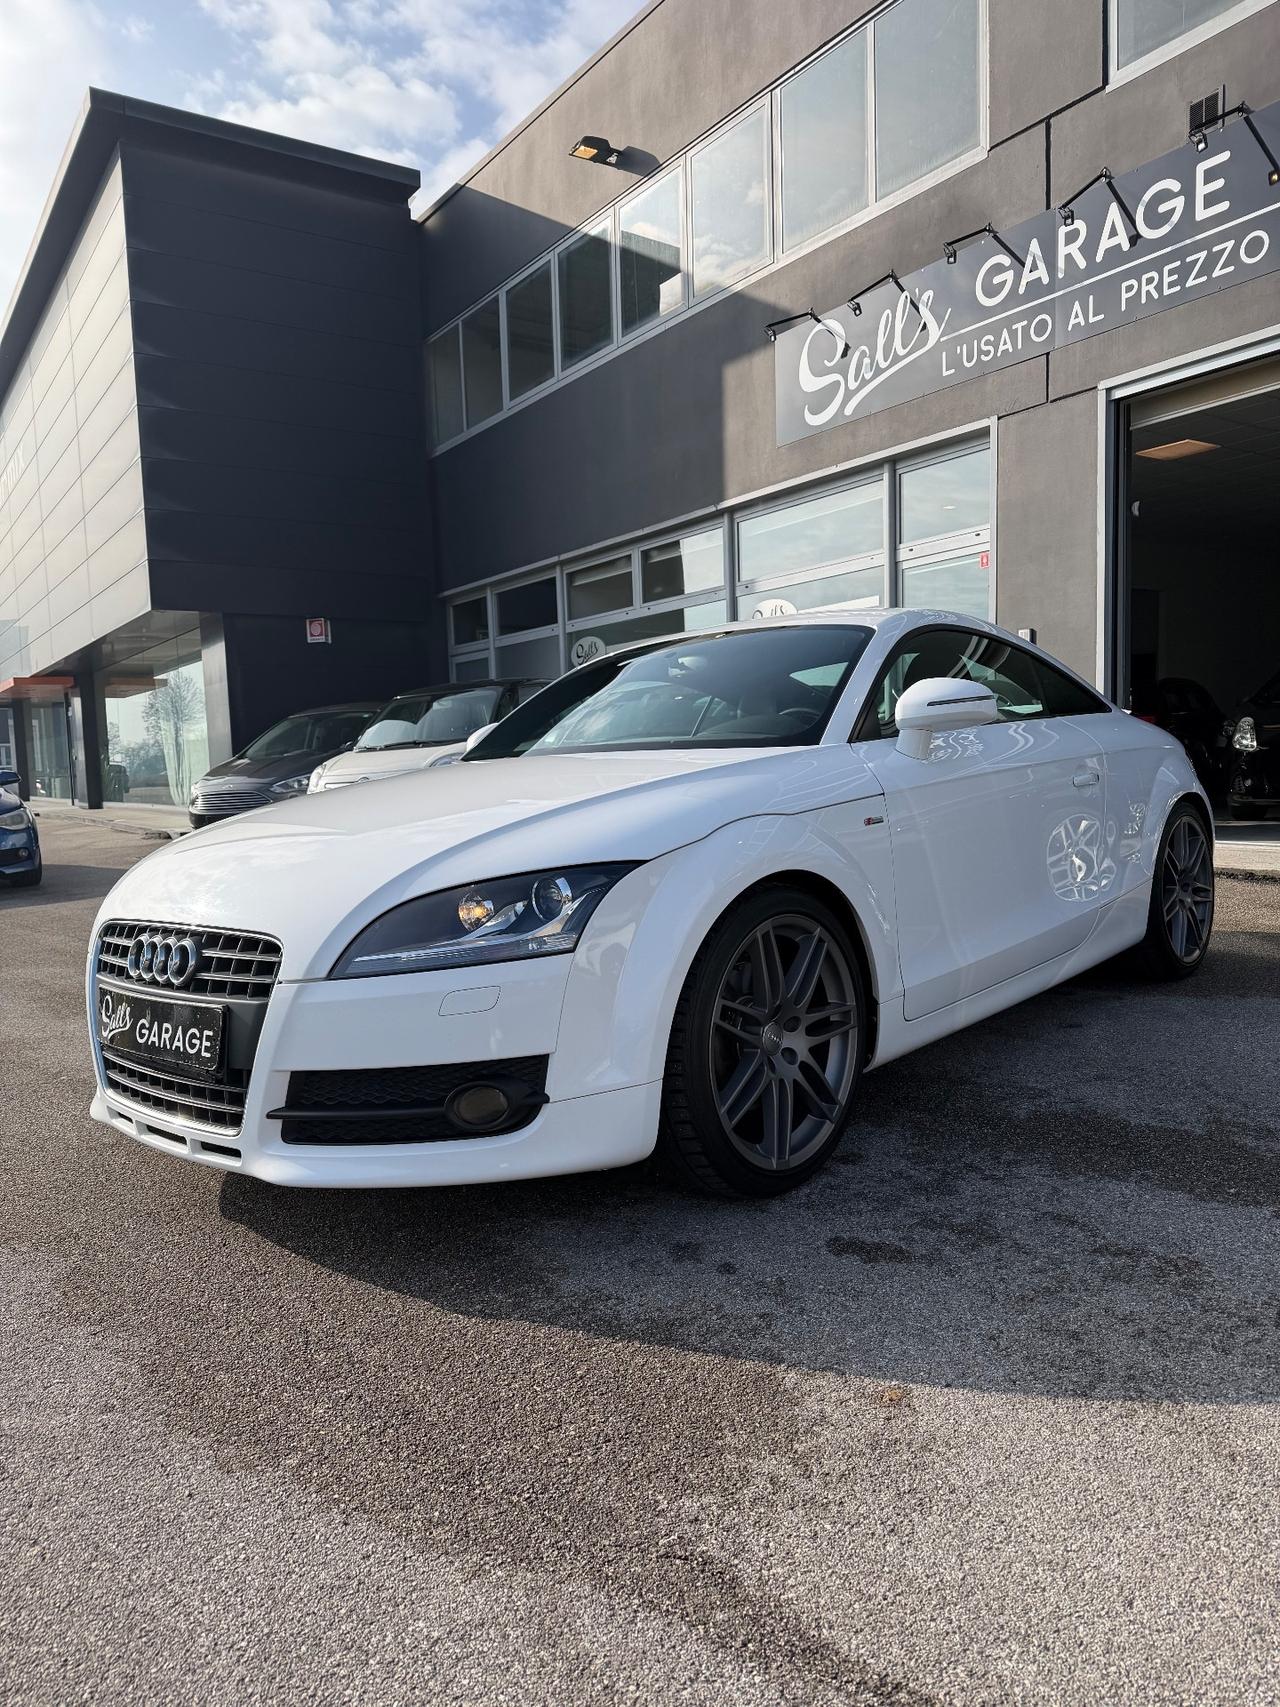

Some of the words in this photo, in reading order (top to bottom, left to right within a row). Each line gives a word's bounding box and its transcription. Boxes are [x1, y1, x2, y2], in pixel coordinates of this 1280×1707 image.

[799, 287, 952, 426] Sall's
[975, 150, 1231, 307] GARAGE
[941, 313, 1052, 376] L'USATO
[1067, 294, 1105, 331] AL
[1121, 230, 1270, 311] PREZZO
[135, 1018, 214, 1058] GARAGE
